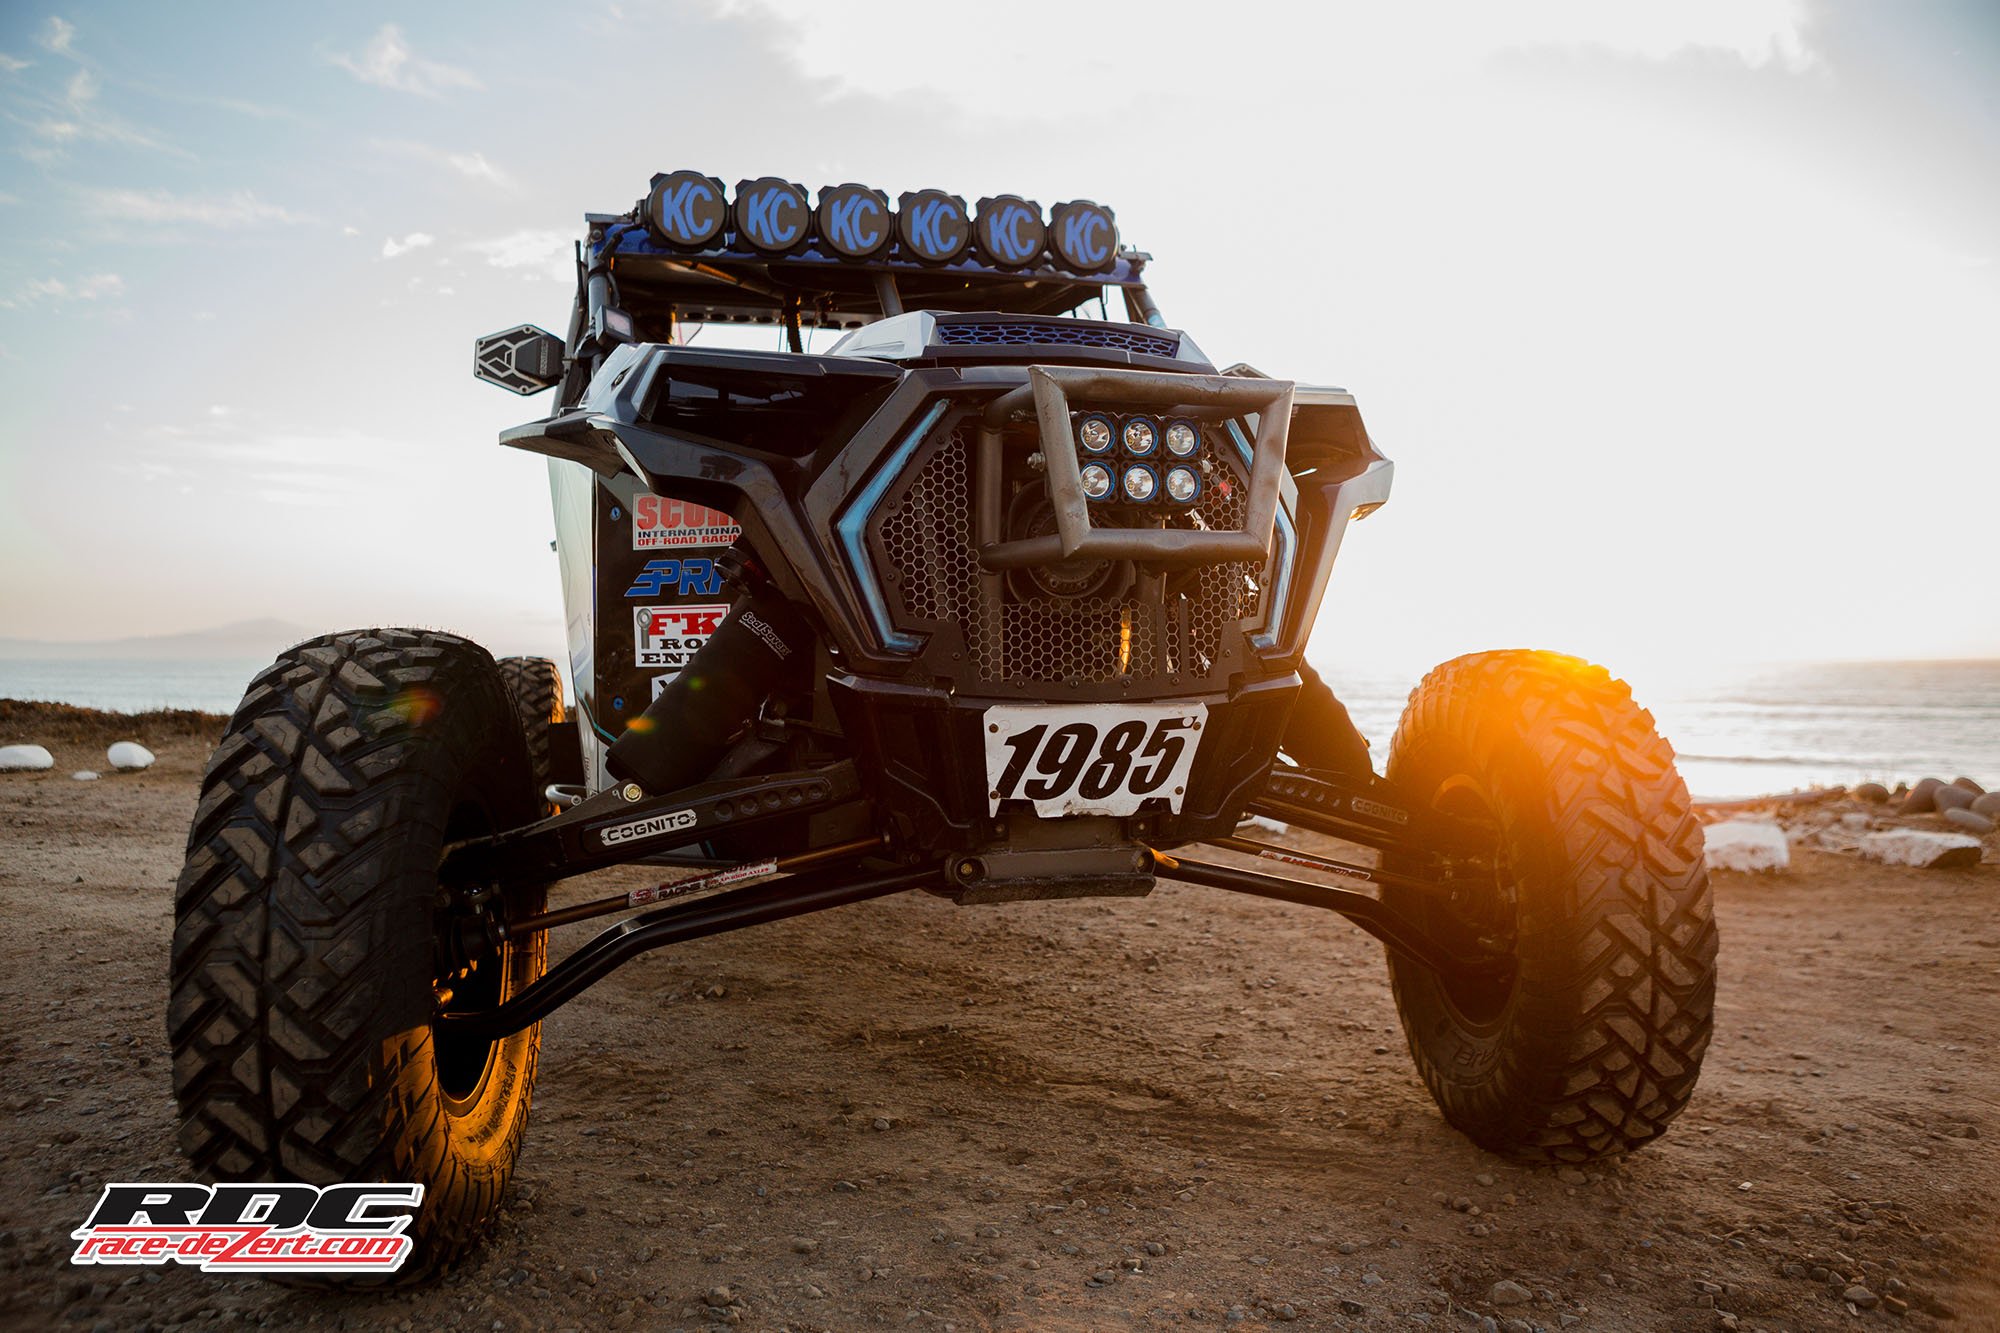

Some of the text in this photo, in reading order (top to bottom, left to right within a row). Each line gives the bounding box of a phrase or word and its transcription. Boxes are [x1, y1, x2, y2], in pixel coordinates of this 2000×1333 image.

[663, 181, 713, 240] KC
[747, 187, 797, 245] KC
[831, 194, 878, 250] KC
[911, 200, 958, 255] KC
[989, 205, 1035, 260] KC
[1064, 210, 1108, 264] KC
[637, 496, 738, 529] SCOR
[638, 537, 697, 546] OFF-ROAD
[648, 612, 723, 635] FK
[660, 639, 709, 650] RO
[995, 716, 1198, 800] 1985
[607, 813, 690, 841] COGNITO
